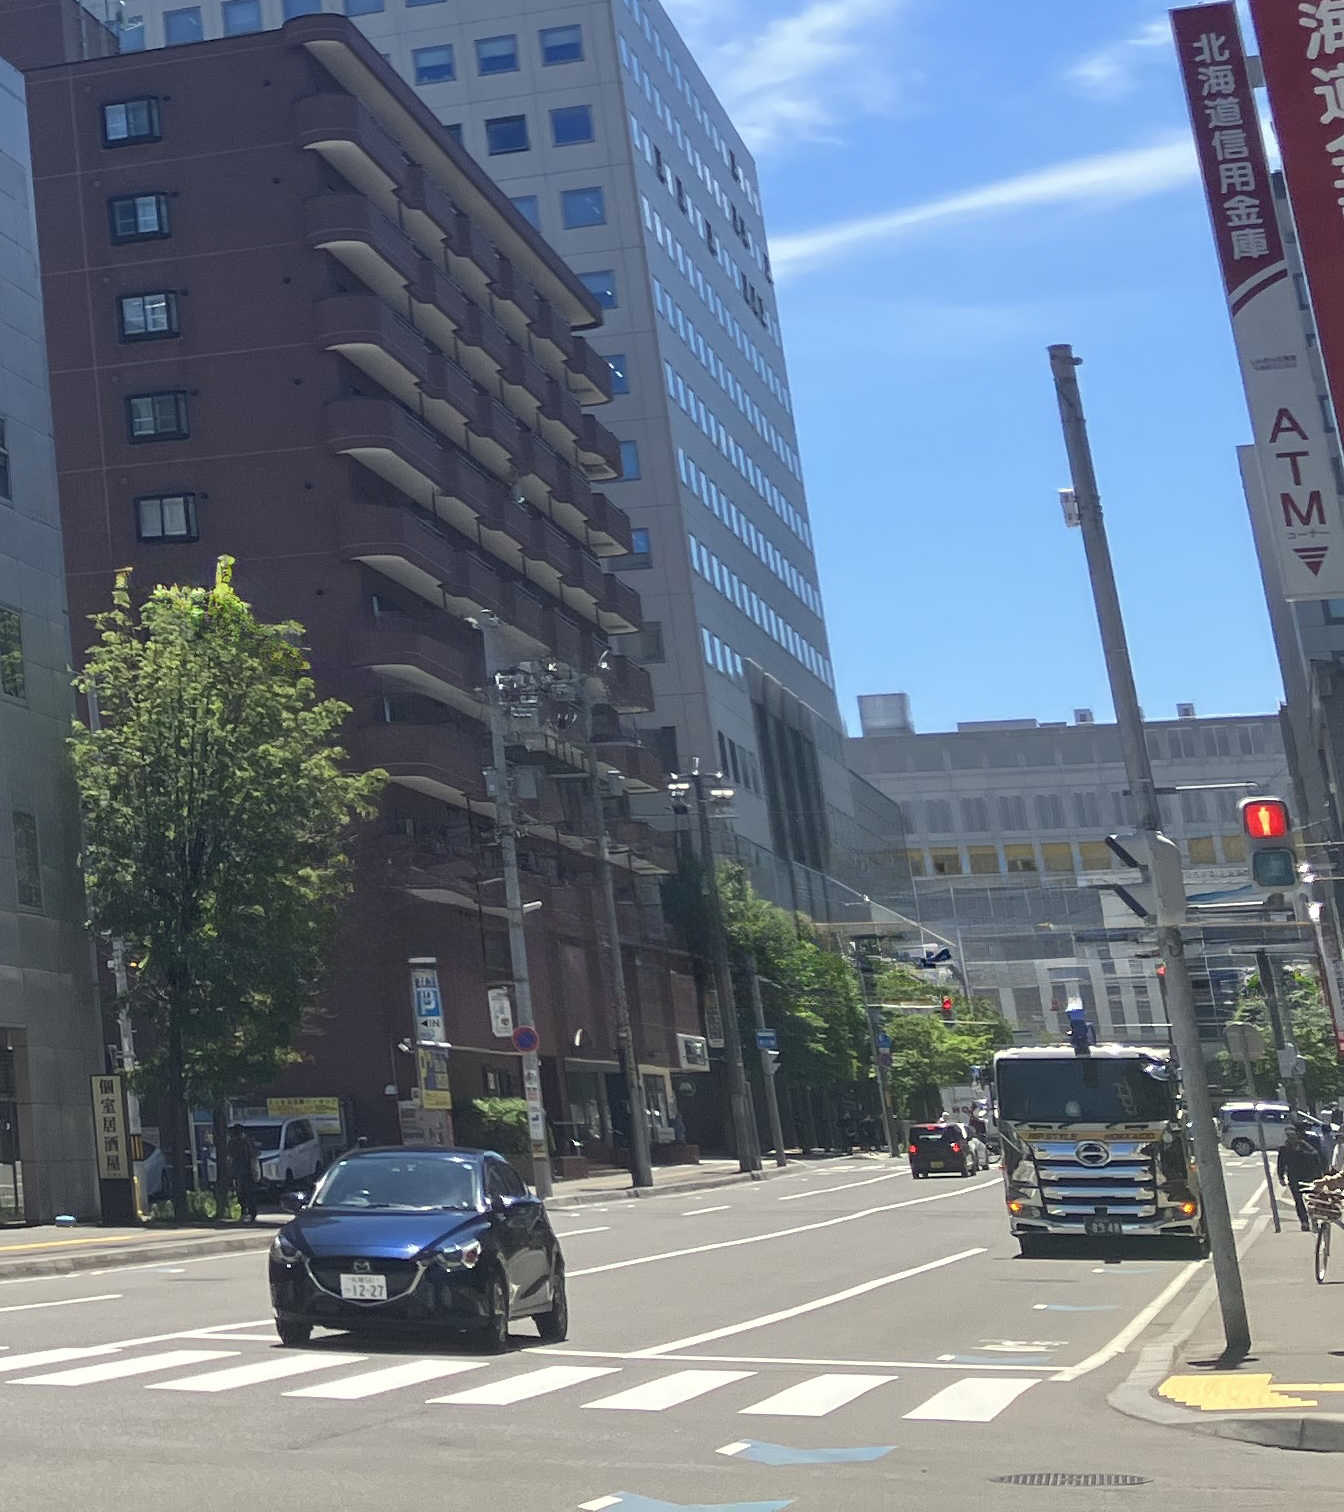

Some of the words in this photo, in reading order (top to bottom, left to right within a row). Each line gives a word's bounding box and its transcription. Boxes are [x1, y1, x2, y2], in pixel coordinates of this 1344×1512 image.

[1193, 33, 1269, 260] 北海道信用金庫
[1269, 407, 1327, 527] ATM
[99, 1078, 121, 1171] 個室居酒屋
